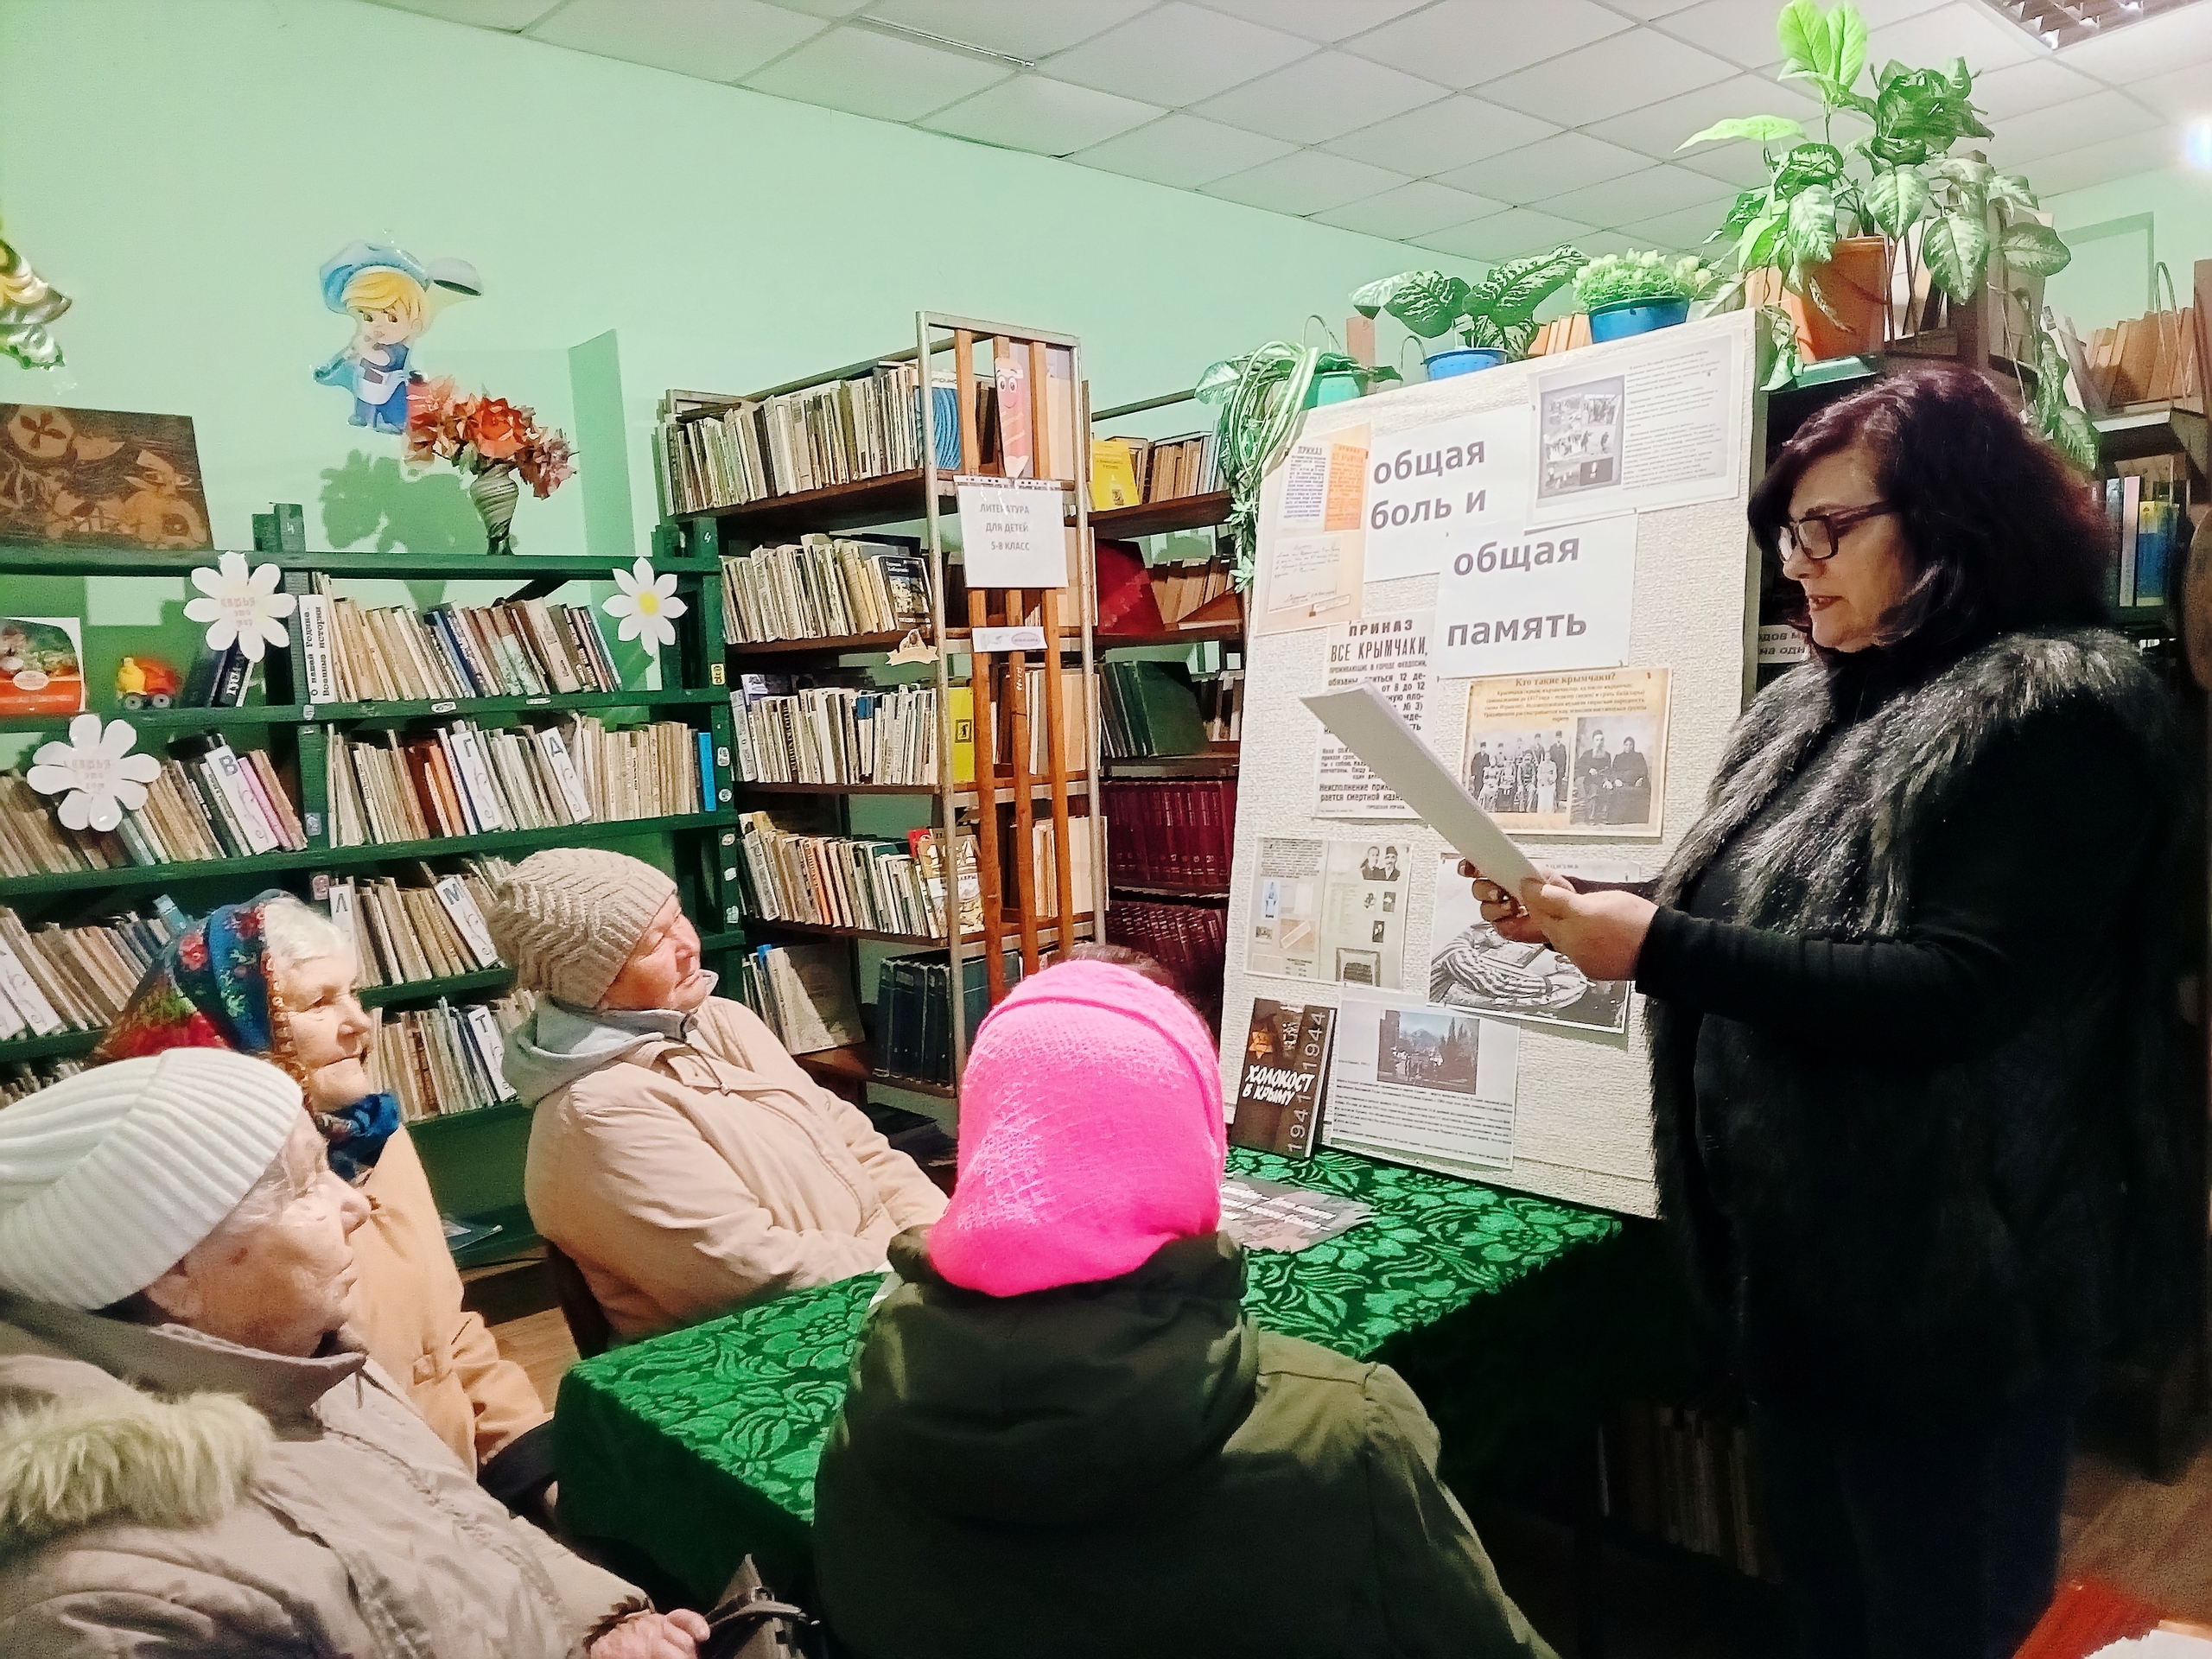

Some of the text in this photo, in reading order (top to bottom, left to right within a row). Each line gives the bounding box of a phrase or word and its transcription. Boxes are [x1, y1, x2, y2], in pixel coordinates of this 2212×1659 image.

[1374, 441, 1484, 484] общая
[1370, 489, 1486, 530] боль и
[986, 522, 1029, 533] ДЛЯ ДЕТЕЙ
[991, 541, 1030, 550] 5-8 КЛАСС
[1453, 537, 1580, 575] общая
[315, 607, 326, 648] истории
[1447, 613, 1587, 647] память
[1331, 636, 1428, 662] ВСЕ КРЫМЧАКИ,
[308, 653, 317, 683] нашей
[1376, 662, 1395, 671] ГОРОДЕ
[1328, 677, 1358, 686] обязаны
[1402, 683, 1412, 692] до
[1417, 682, 1426, 690] 12
[1535, 677, 1560, 685] такие
[1561, 672, 1616, 685] крымчаки?
[463, 738, 472, 758] Г
[549, 736, 564, 758] Д
[219, 754, 238, 777] В
[1346, 793, 1380, 802] смертной
[335, 893, 348, 913] Л
[442, 883, 464, 906] М
[475, 1014, 489, 1033] Т
[1302, 1011, 1326, 1072] 1944
[1245, 1065, 1315, 1093] ХОЛОКОСТ
[1242, 1083, 1295, 1106] В КРЫМУ
[1287, 1093, 1312, 1154] 1941
